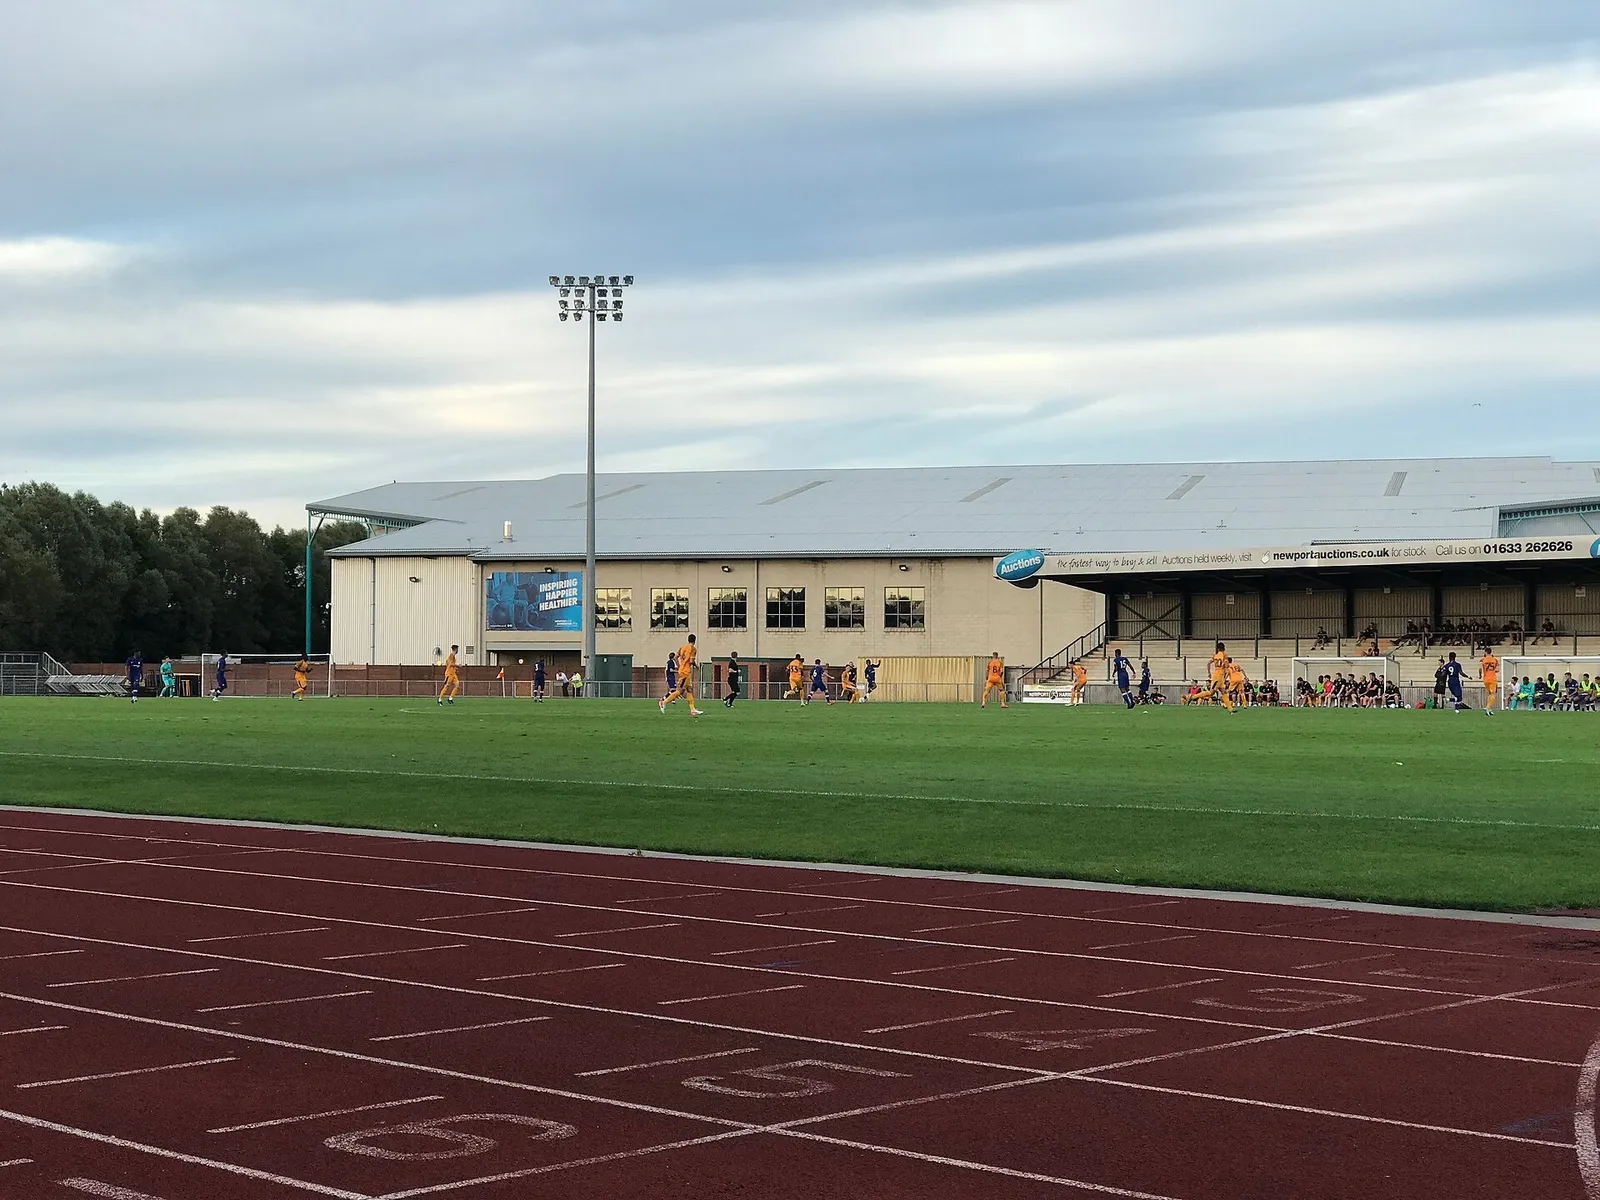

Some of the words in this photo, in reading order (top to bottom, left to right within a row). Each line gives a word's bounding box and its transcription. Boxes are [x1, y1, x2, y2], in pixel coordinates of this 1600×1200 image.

[1273, 547, 1390, 562] newportauctions.co.uk
[1391, 546, 1402, 557] for
[1403, 545, 1427, 556] stock
[1435, 544, 1454, 556] Call
[1454, 546, 1467, 555] us
[1468, 545, 1482, 555] on
[1483, 543, 1522, 554] 01633
[1525, 540, 1573, 553] 262626
[1000, 556, 1041, 575] Auctions
[1057, 559, 1067, 568] the
[1069, 557, 1093, 570] fastest
[1095, 559, 1111, 571] way
[1112, 558, 1119, 566] to
[1121, 557, 1137, 570] buy
[1137, 557, 1144, 565] &
[1146, 556, 1158, 565] sell
[1161, 555, 1193, 565] Auctions
[1193, 554, 1210, 564] held
[1211, 554, 1237, 565] weekly,
[1238, 553, 1252, 562] visit
[539, 578, 578, 592] INSPIRING
[545, 588, 578, 601] HAPPIER
[539, 597, 578, 612] HEALTHIER
[1119, 659, 1127, 669] 15
[1448, 666, 1454, 676] 9
[1191, 987, 1368, 1013] 3
[968, 1027, 1157, 1052] 4
[681, 1058, 914, 1099] 5
[322, 1112, 579, 1161] 6
